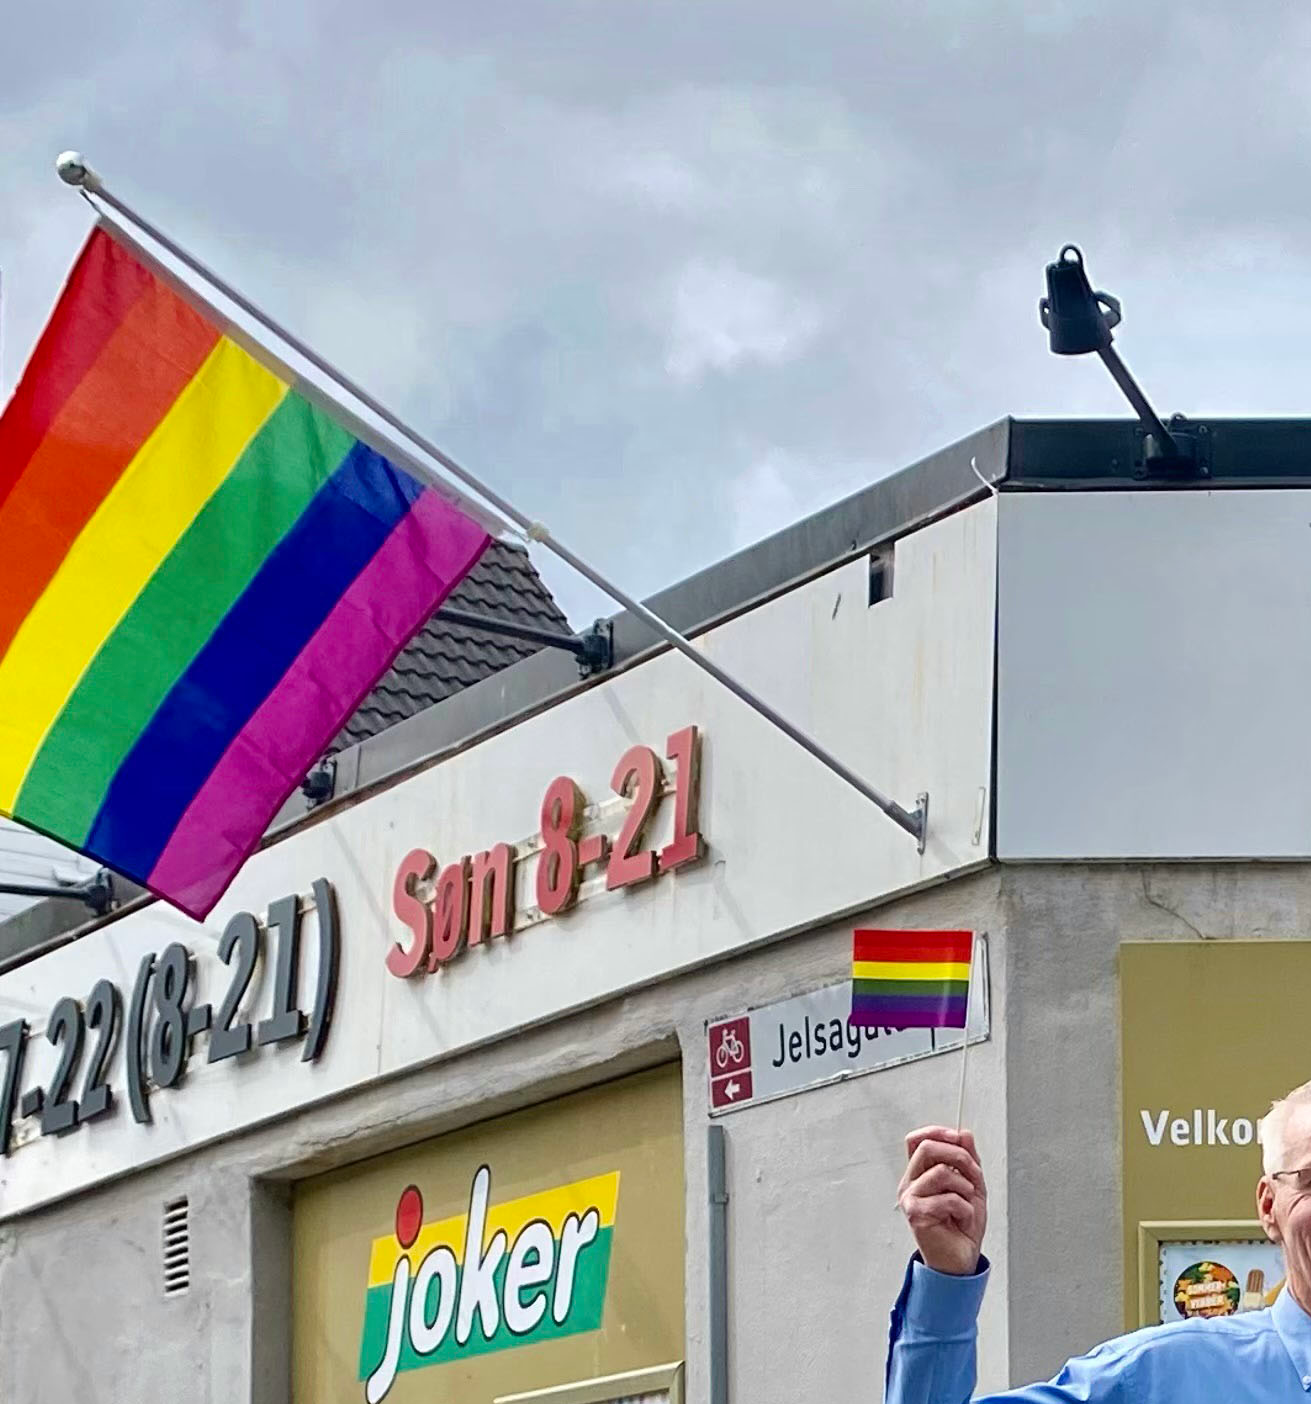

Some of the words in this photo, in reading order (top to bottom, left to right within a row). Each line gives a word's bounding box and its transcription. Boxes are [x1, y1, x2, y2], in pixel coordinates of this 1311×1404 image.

[386, 842, 518, 979] Søn
[536, 724, 706, 915] 8-21
[1140, 1109, 1264, 1146] Velko
